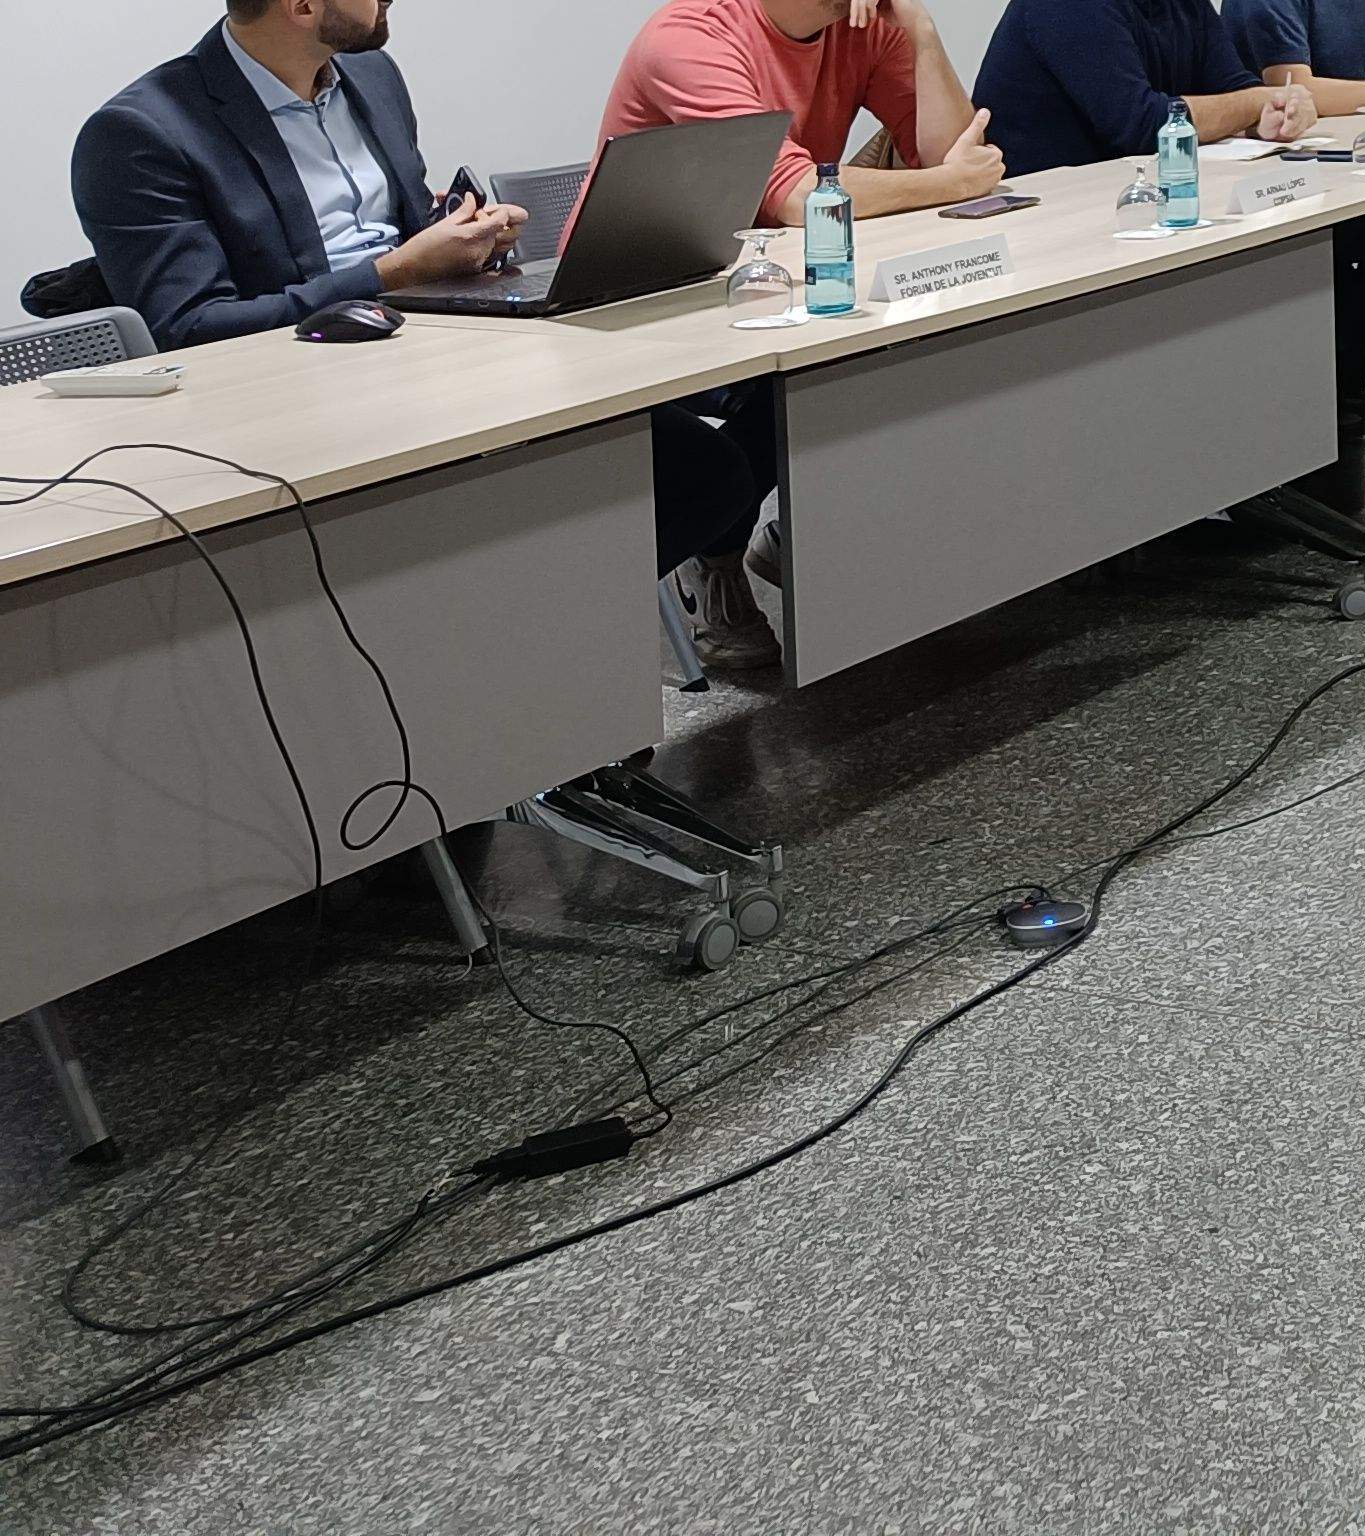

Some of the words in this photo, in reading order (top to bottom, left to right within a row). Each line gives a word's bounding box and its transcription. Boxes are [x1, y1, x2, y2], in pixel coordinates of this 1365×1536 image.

[1254, 189, 1265, 199] SR.
[894, 272, 910, 285] SR.
[911, 263, 954, 280] ANTHONY
[954, 251, 1002, 269] FRANCOME
[934, 279, 948, 291] DE
[948, 276, 961, 287] LA
[961, 265, 1003, 284] JOVENTUT
